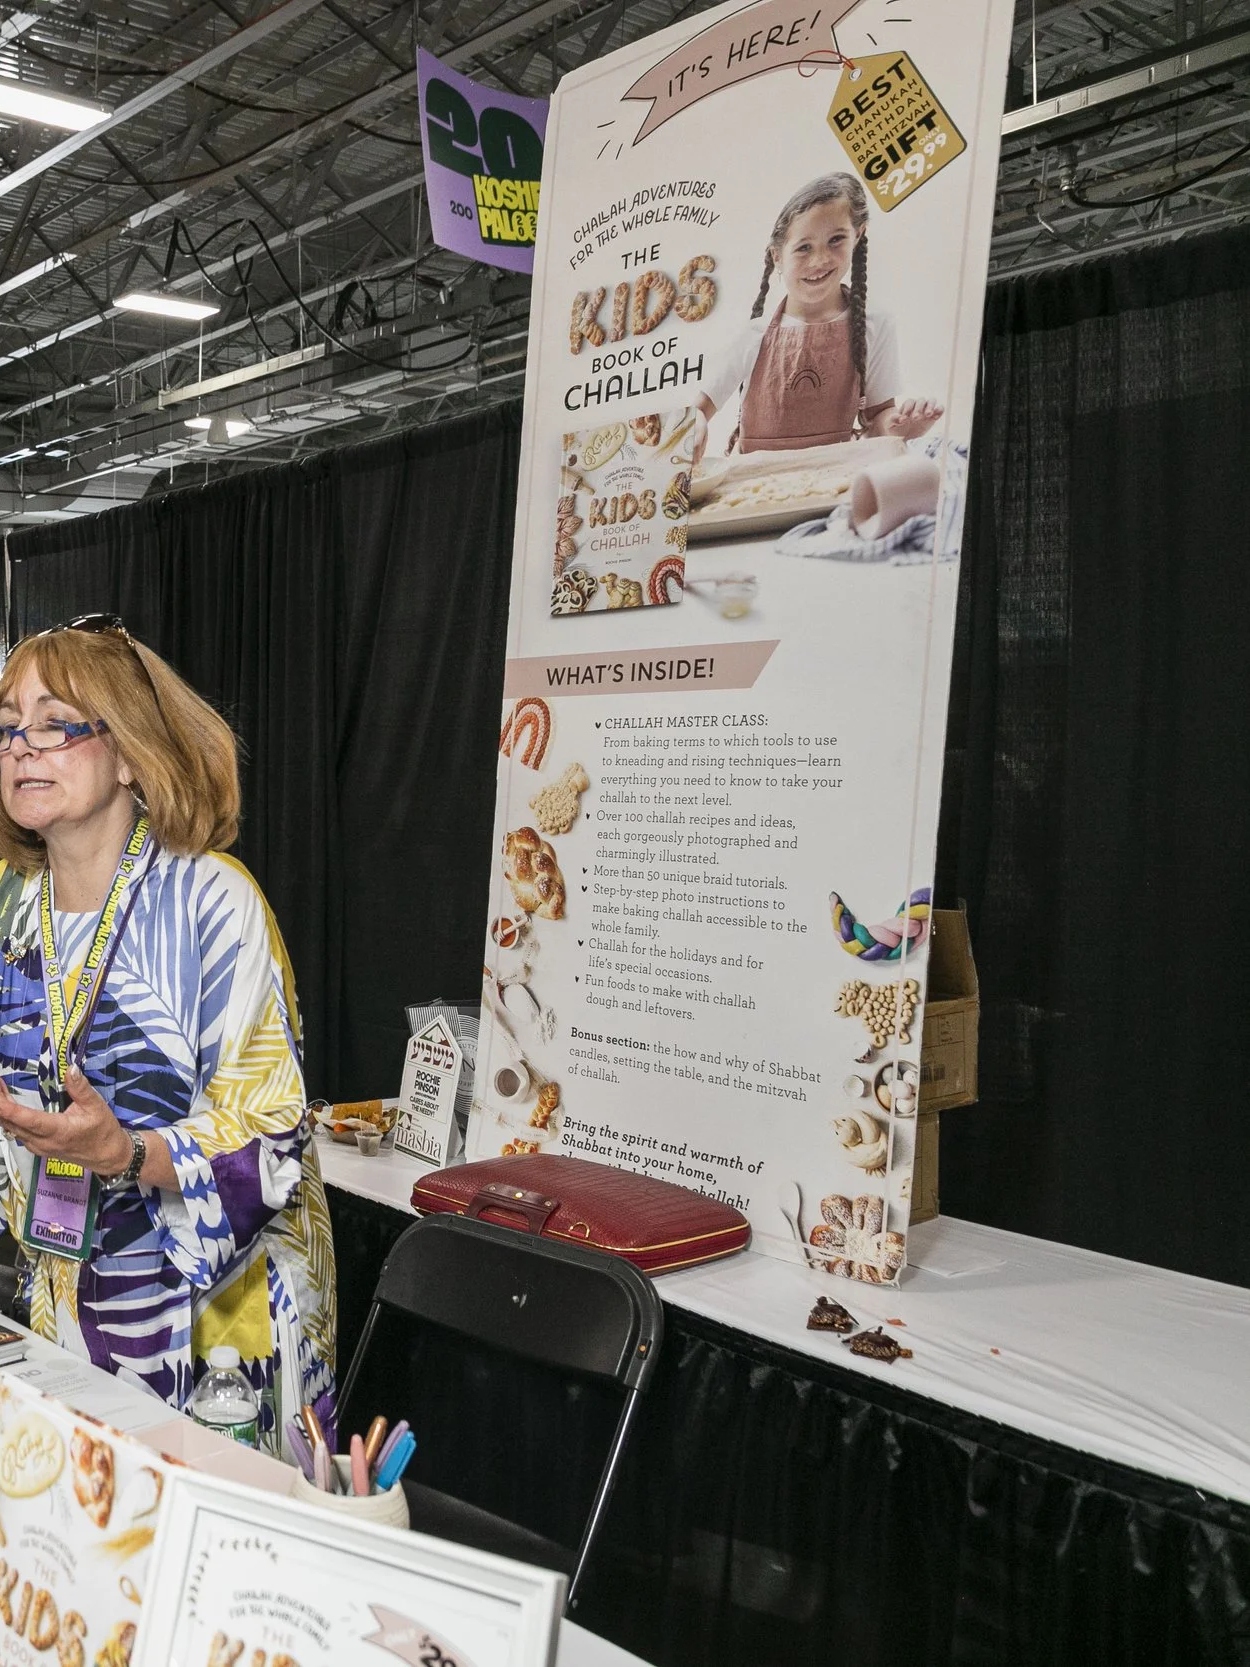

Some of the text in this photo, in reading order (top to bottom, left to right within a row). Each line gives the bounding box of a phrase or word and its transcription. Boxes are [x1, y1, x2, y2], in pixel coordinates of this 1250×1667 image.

[668, 10, 821, 97] IT'S HERE!
[833, 58, 908, 132] BEST
[846, 79, 917, 141] CHANUKAH
[852, 88, 923, 152] BIRTHDAY
[857, 101, 931, 164] BAT MITZVAH
[864, 109, 937, 181] GIFT
[919, 125, 941, 146] ONLY
[450, 200, 473, 220] 200
[573, 180, 716, 244] CHALLAH ADVENTURES
[569, 205, 720, 270] FOR THE WHOLE FAMILY
[621, 242, 661, 270] THE
[569, 254, 717, 356] KIDS
[591, 336, 678, 374] BOOK OF
[563, 354, 703, 411] CHALLAH
[616, 481, 633, 491] THE
[589, 489, 657, 529] KIDS
[590, 532, 650, 552] CHALLAH
[602, 523, 640, 536] BOOK OF
[546, 657, 714, 686] WHAT'S INSIDE!
[605, 714, 768, 729] CHALLAH MASTER CLASS:
[603, 733, 837, 749] From baking terms to which tools to use
[602, 757, 612, 766] to
[615, 754, 664, 768] kneading
[667, 754, 688, 766] and
[692, 755, 725, 769] rising
[600, 791, 732, 806] challah to the next level.
[596, 810, 796, 829] Over 100 challah recipes and ideas,
[596, 846, 719, 865] charmingly illustrated.
[593, 865, 788, 890] More than 50 unique braid tutorials.
[593, 883, 785, 910] Step-by-step photo instructions to
[87, 875, 130, 969] KOSHERPALOOZA
[591, 919, 660, 939] whole family.
[588, 937, 764, 969] Challah for the holidays and for
[588, 955, 712, 983] life's special occasions.
[586, 992, 695, 1020] dough and leftovers.
[570, 1027, 822, 1084] Bonus section: the how and why of Shabbat
[416, 1070, 441, 1085] ROCHIE
[568, 1063, 620, 1084] of challah.
[414, 1080, 440, 1097] PINSON
[409, 1096, 423, 1107] CARES
[423, 1100, 440, 1112] ABOUT
[411, 1103, 422, 1112] THE
[396, 1126, 441, 1159] masbia
[563, 1116, 764, 1175] Bring the spirit and warmth of
[561, 1134, 717, 1185] Shabbat into your home,
[36, 1225, 77, 1246] EXHIBITOR
